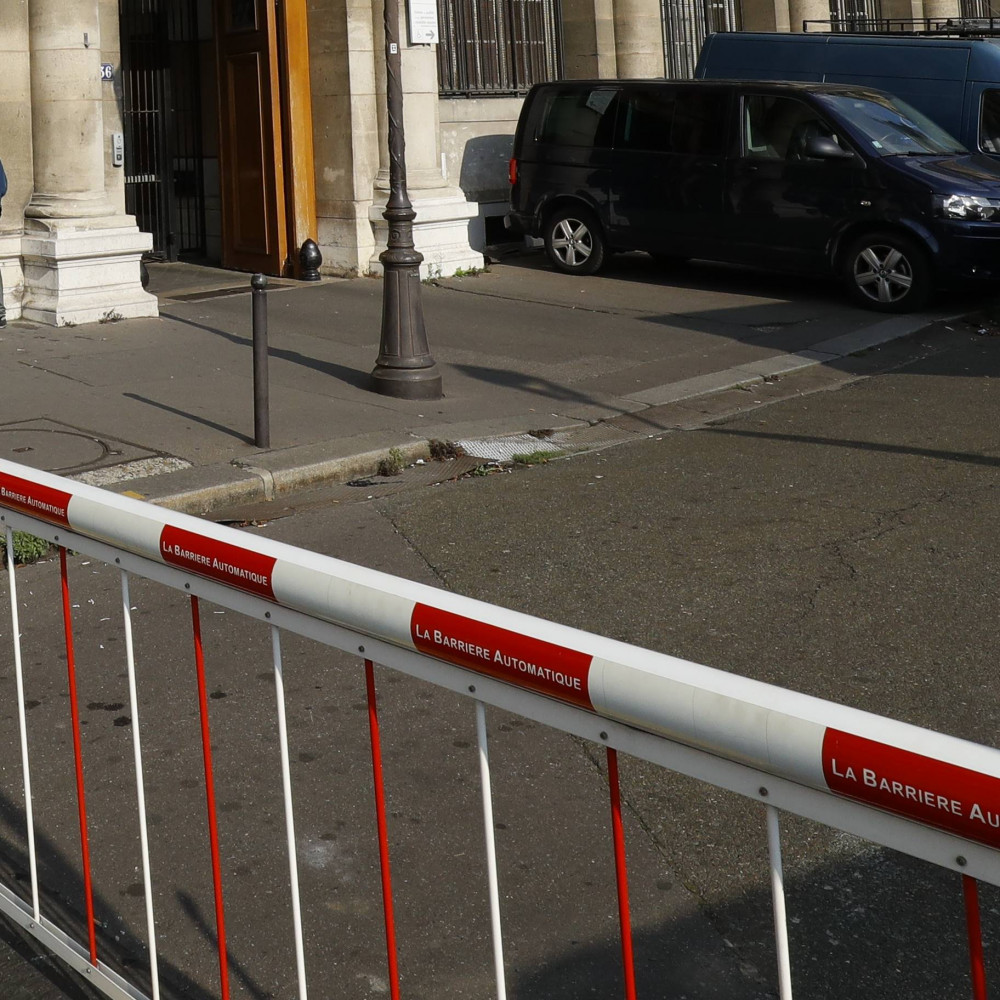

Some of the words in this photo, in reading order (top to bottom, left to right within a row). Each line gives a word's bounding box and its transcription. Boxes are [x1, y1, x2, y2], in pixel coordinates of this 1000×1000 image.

[1, 487, 26, 504] BARRIERE
[27, 495, 65, 517] AUTOMATIQUE
[162, 541, 173, 553] LA
[174, 544, 211, 567] BARRIERE
[212, 557, 268, 586] AUTOMATIQUE
[416, 624, 431, 641] LA
[433, 630, 491, 661] BARRIERE
[493, 650, 582, 691] AUTOMATIQUE
[831, 758, 857, 782] LA
[862, 767, 963, 816] BARRIERE
